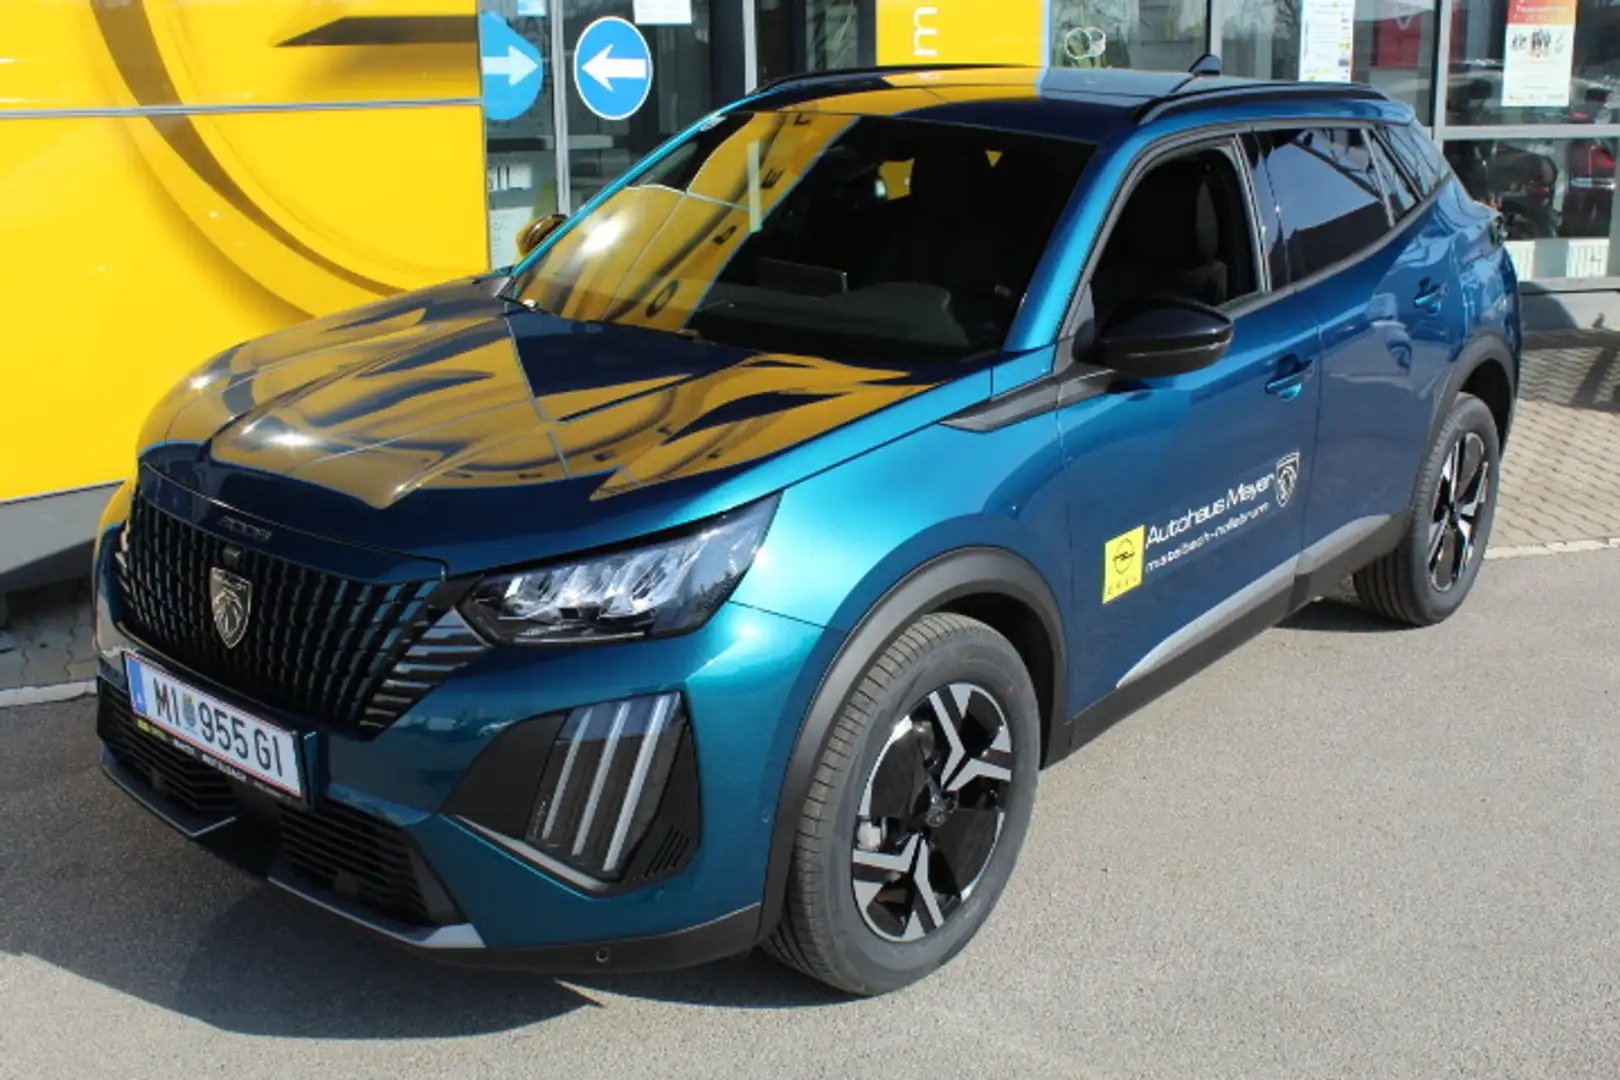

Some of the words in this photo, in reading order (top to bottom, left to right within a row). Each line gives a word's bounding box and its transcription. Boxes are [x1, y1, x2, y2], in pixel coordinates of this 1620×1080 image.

[1145, 498, 1226, 550] Autohaus
[153, 677, 181, 726] MI
[198, 701, 249, 759] 955
